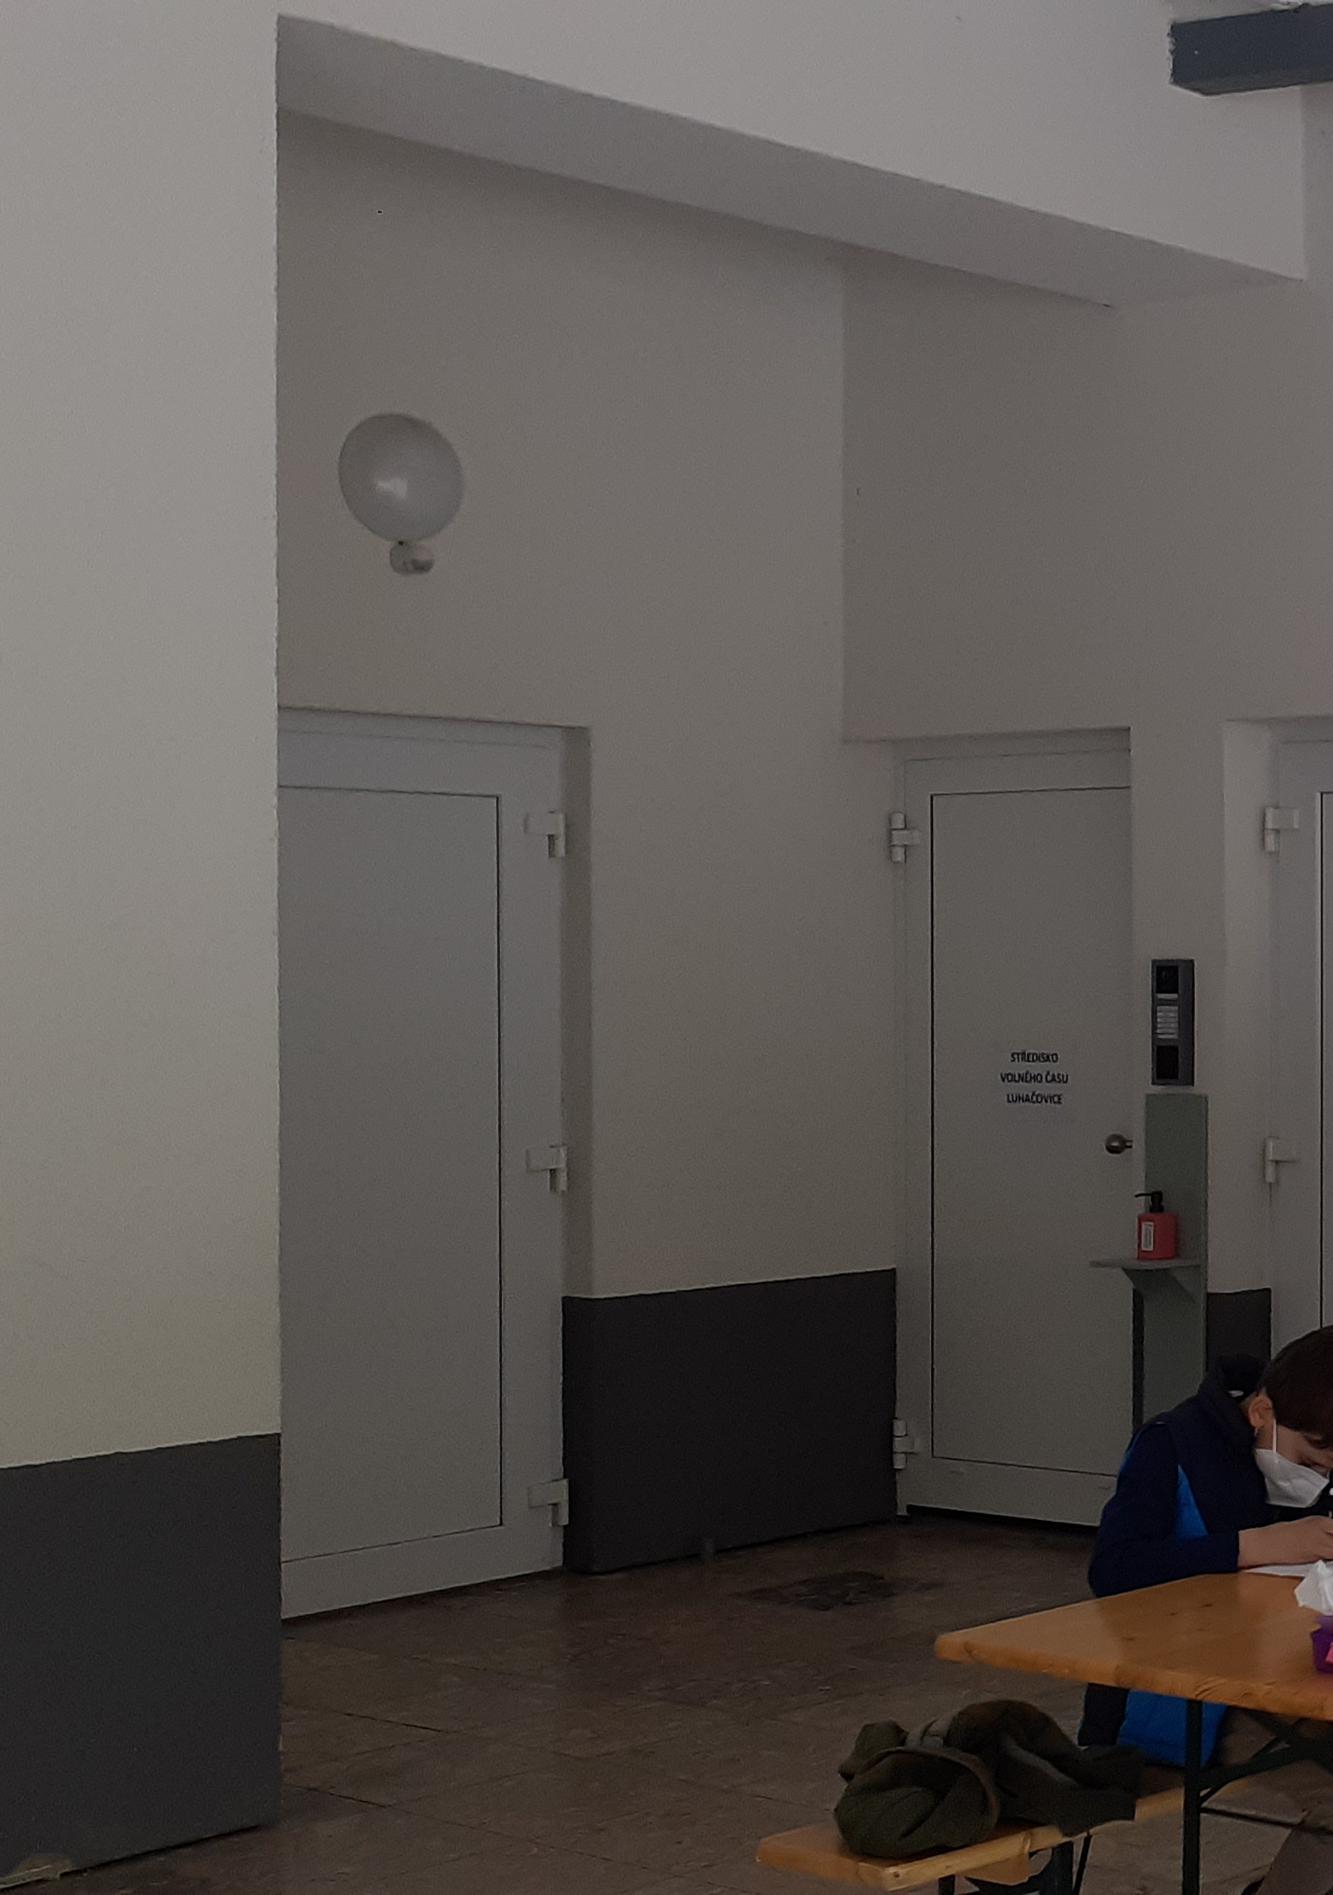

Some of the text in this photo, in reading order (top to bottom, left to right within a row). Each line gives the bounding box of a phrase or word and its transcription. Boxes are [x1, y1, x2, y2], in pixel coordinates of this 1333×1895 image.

[1010, 1050, 1059, 1063] STŘEDISKO
[1000, 1070, 1069, 1084] VOLNÉHO ČASU
[1006, 1091, 1063, 1105] LUHAČOVICE
